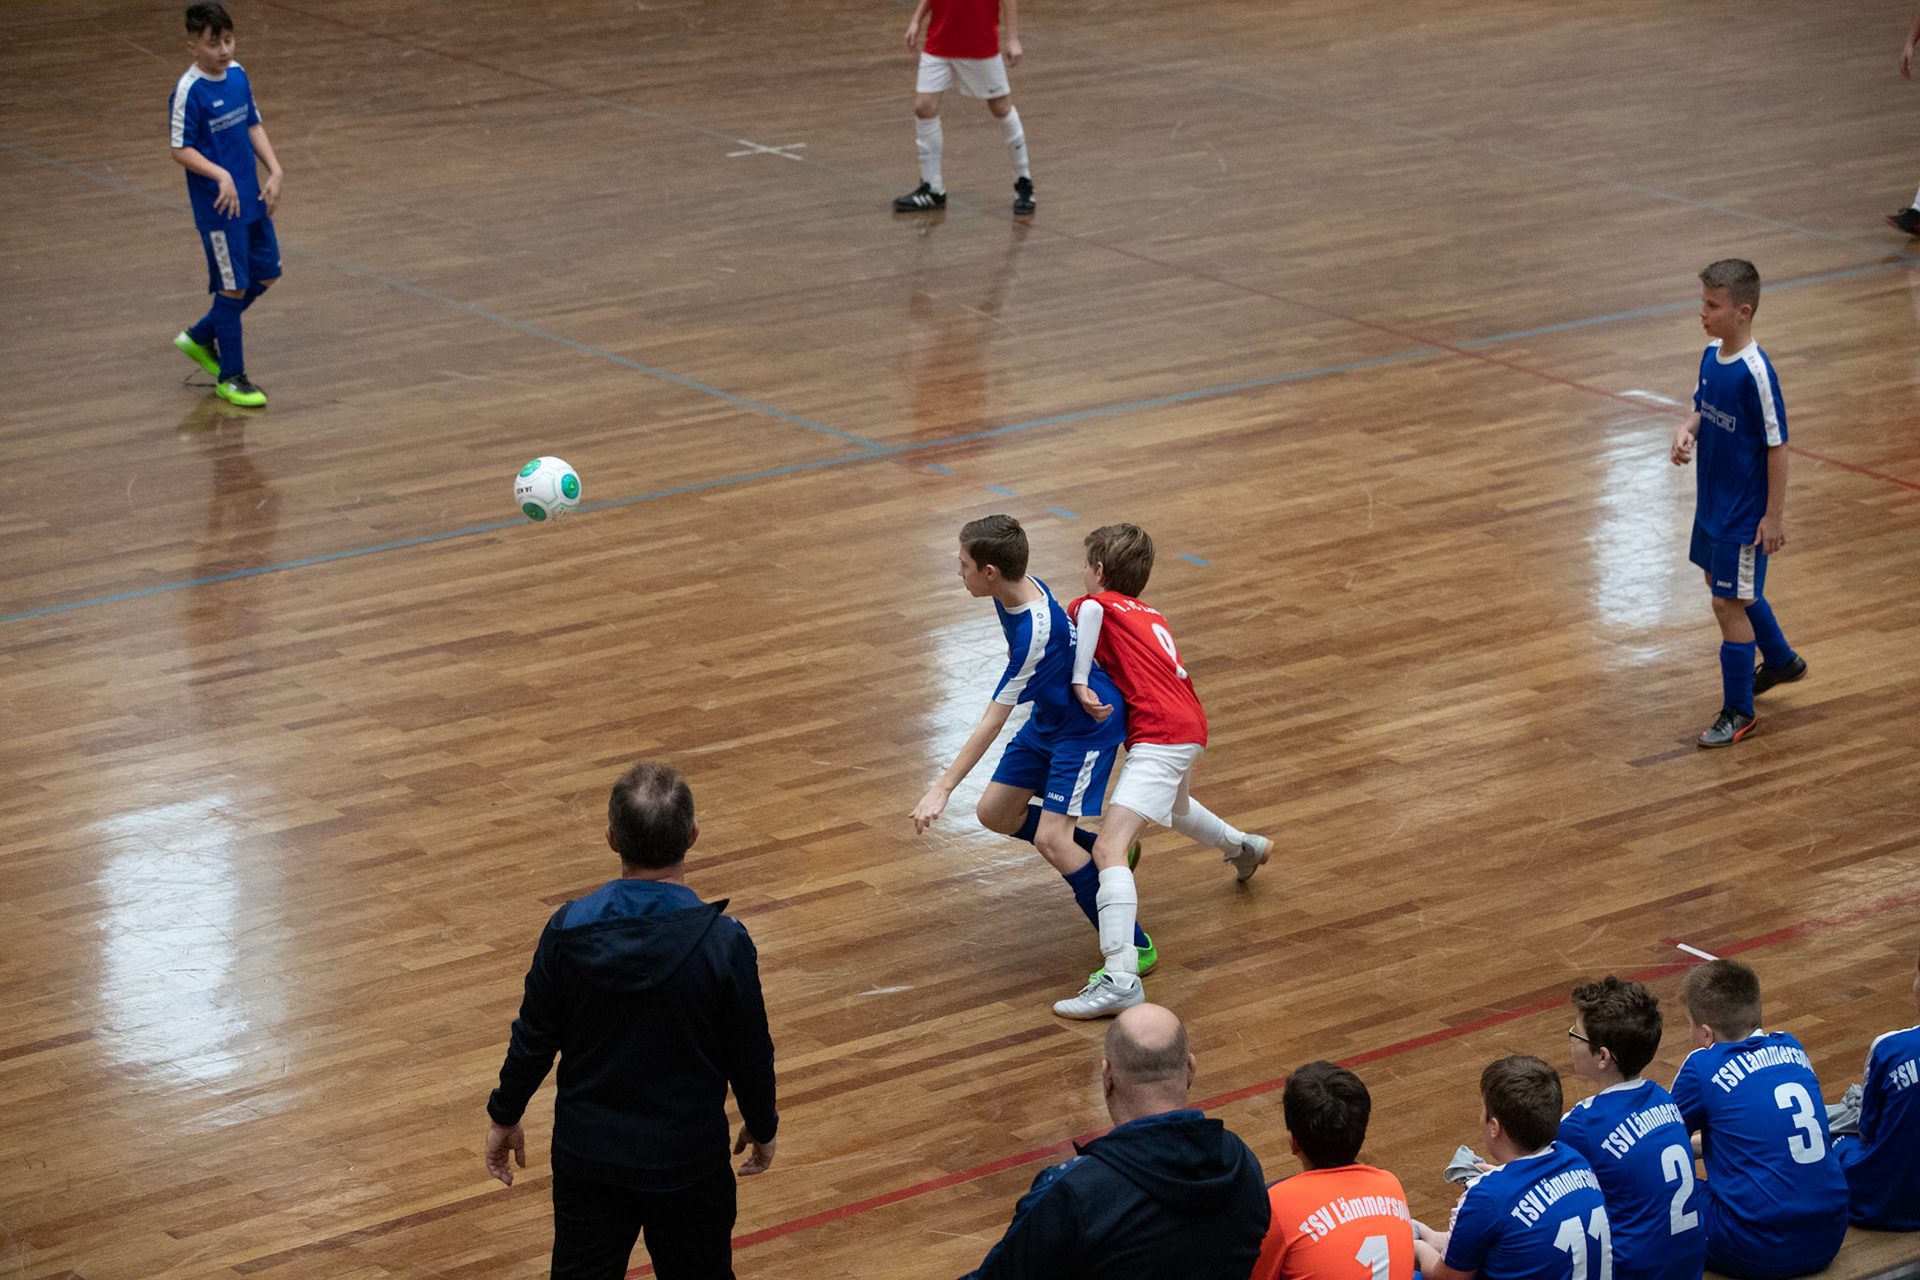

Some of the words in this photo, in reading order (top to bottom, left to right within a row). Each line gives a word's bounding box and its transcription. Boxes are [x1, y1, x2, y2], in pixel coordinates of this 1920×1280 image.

[1047, 791, 1065, 803] JAKO
[1710, 1059, 1746, 1094] TSV
[1736, 1045, 1817, 1077] Lämmersp
[1888, 1059, 1919, 1091] TSV
[1600, 1117, 1637, 1160] TSV
[1631, 1102, 1685, 1139] Lämmers
[1773, 1081, 1826, 1165] 3
[1510, 1189, 1547, 1229] TSV
[1660, 1143, 1699, 1236] 2
[1298, 1206, 1337, 1243] TSV
[1552, 1204, 1614, 1280] 11
[1354, 1234, 1390, 1280] 1
